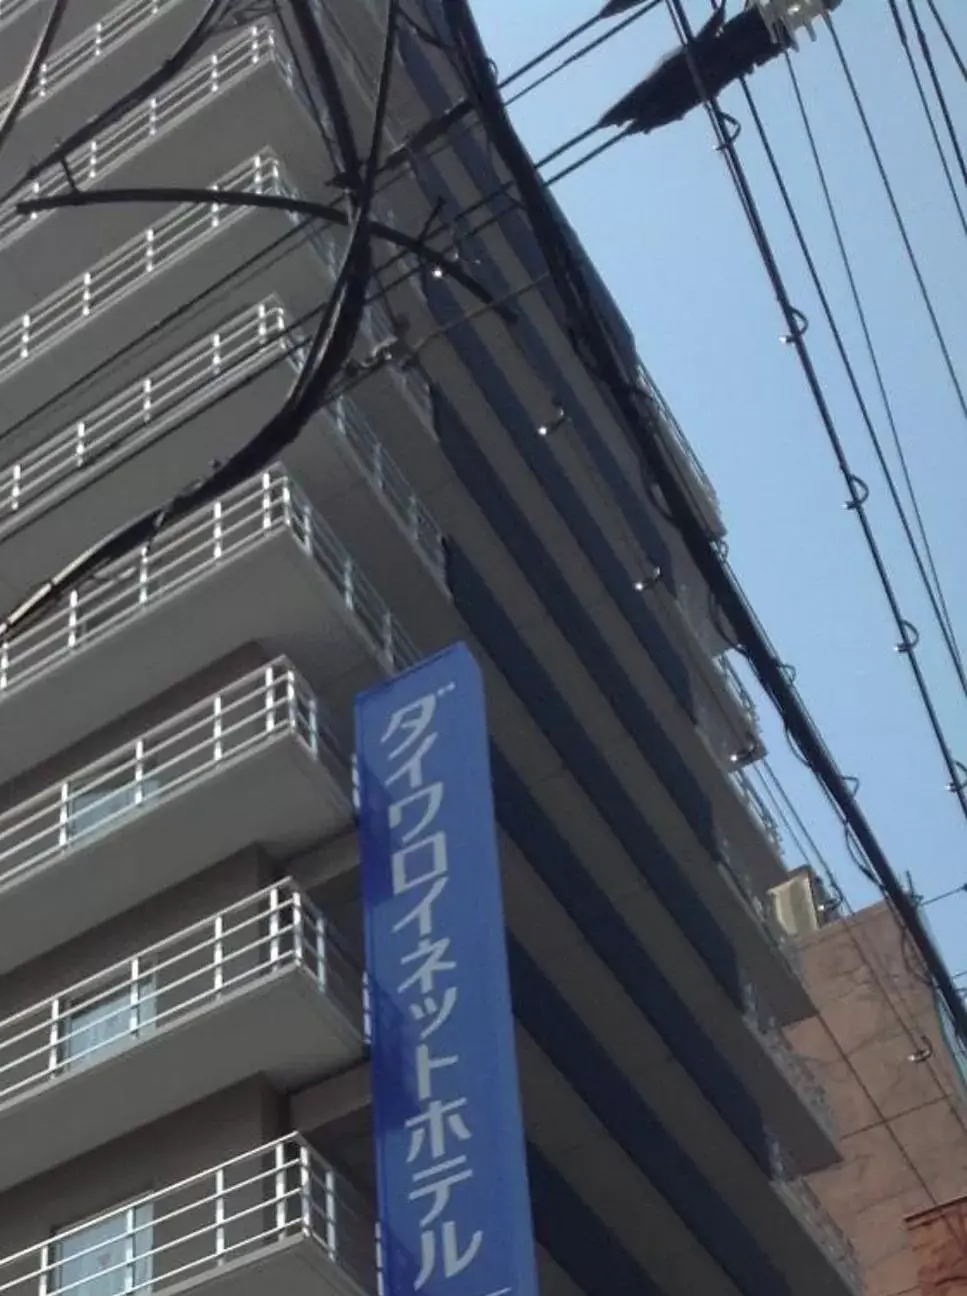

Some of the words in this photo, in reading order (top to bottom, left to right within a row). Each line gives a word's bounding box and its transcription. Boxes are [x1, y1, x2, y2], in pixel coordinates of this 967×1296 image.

[381, 681, 483, 1291] ダイワロイネットホテル
